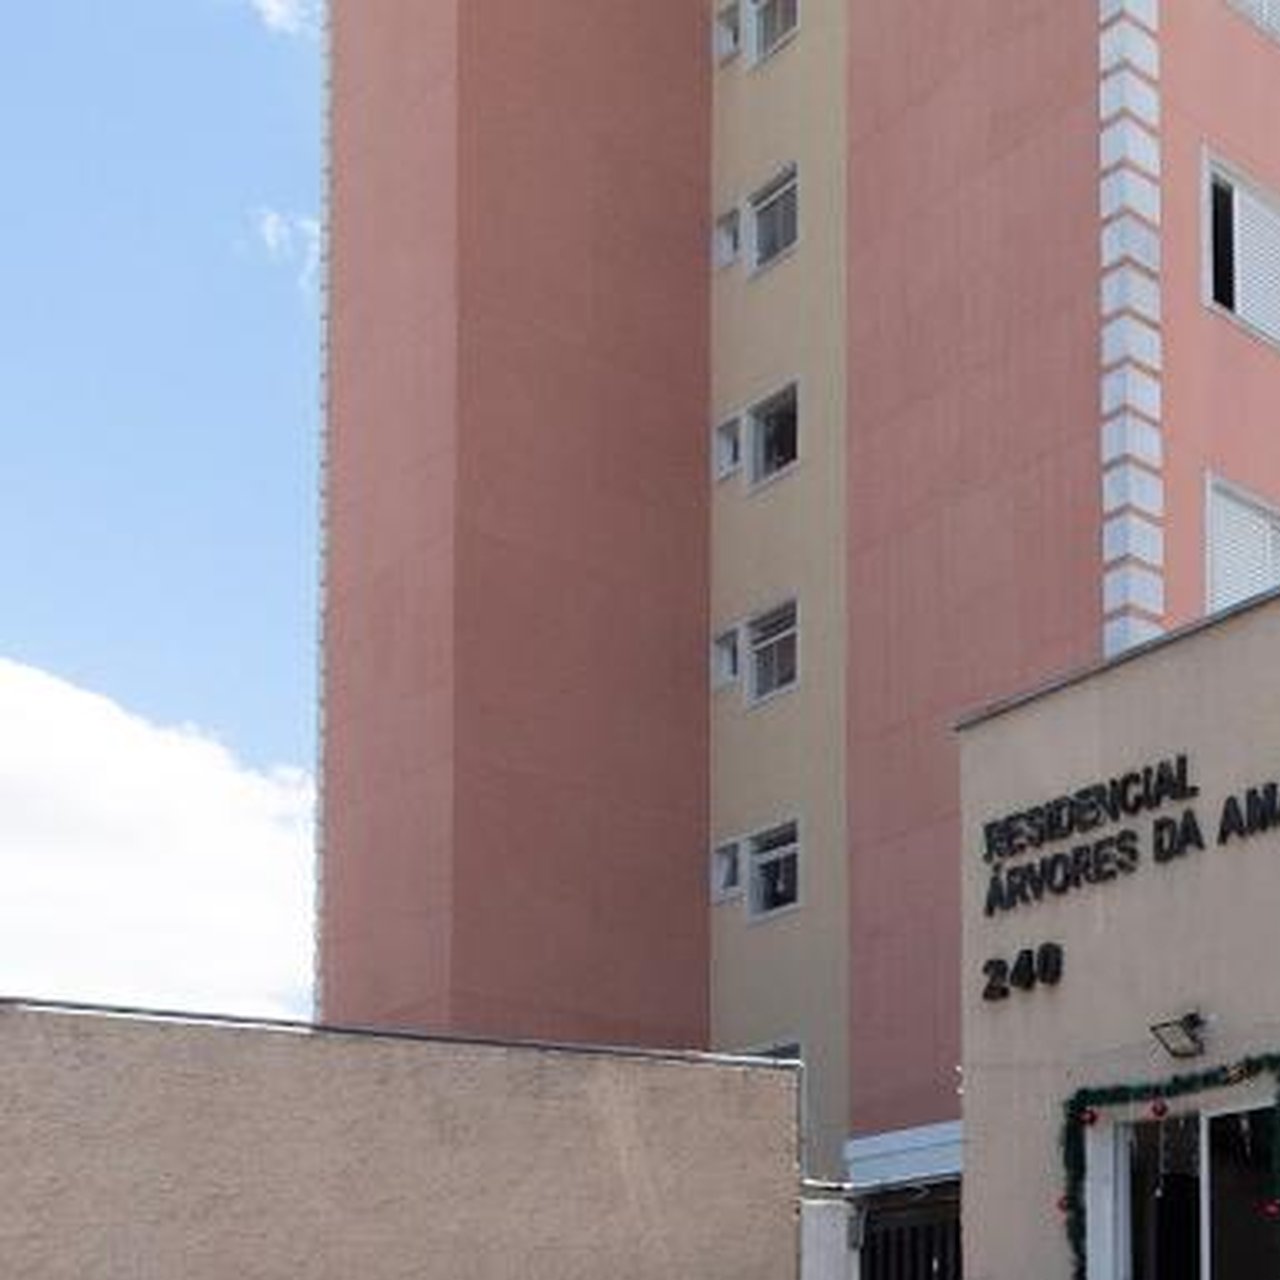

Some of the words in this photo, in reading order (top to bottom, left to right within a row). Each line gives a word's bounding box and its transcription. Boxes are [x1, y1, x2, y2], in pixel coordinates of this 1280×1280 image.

[984, 755, 1199, 862] RESIDENCIAL
[985, 830, 1140, 917] ÁRVORES
[1152, 810, 1205, 863] DA
[982, 943, 1063, 1002] 240
